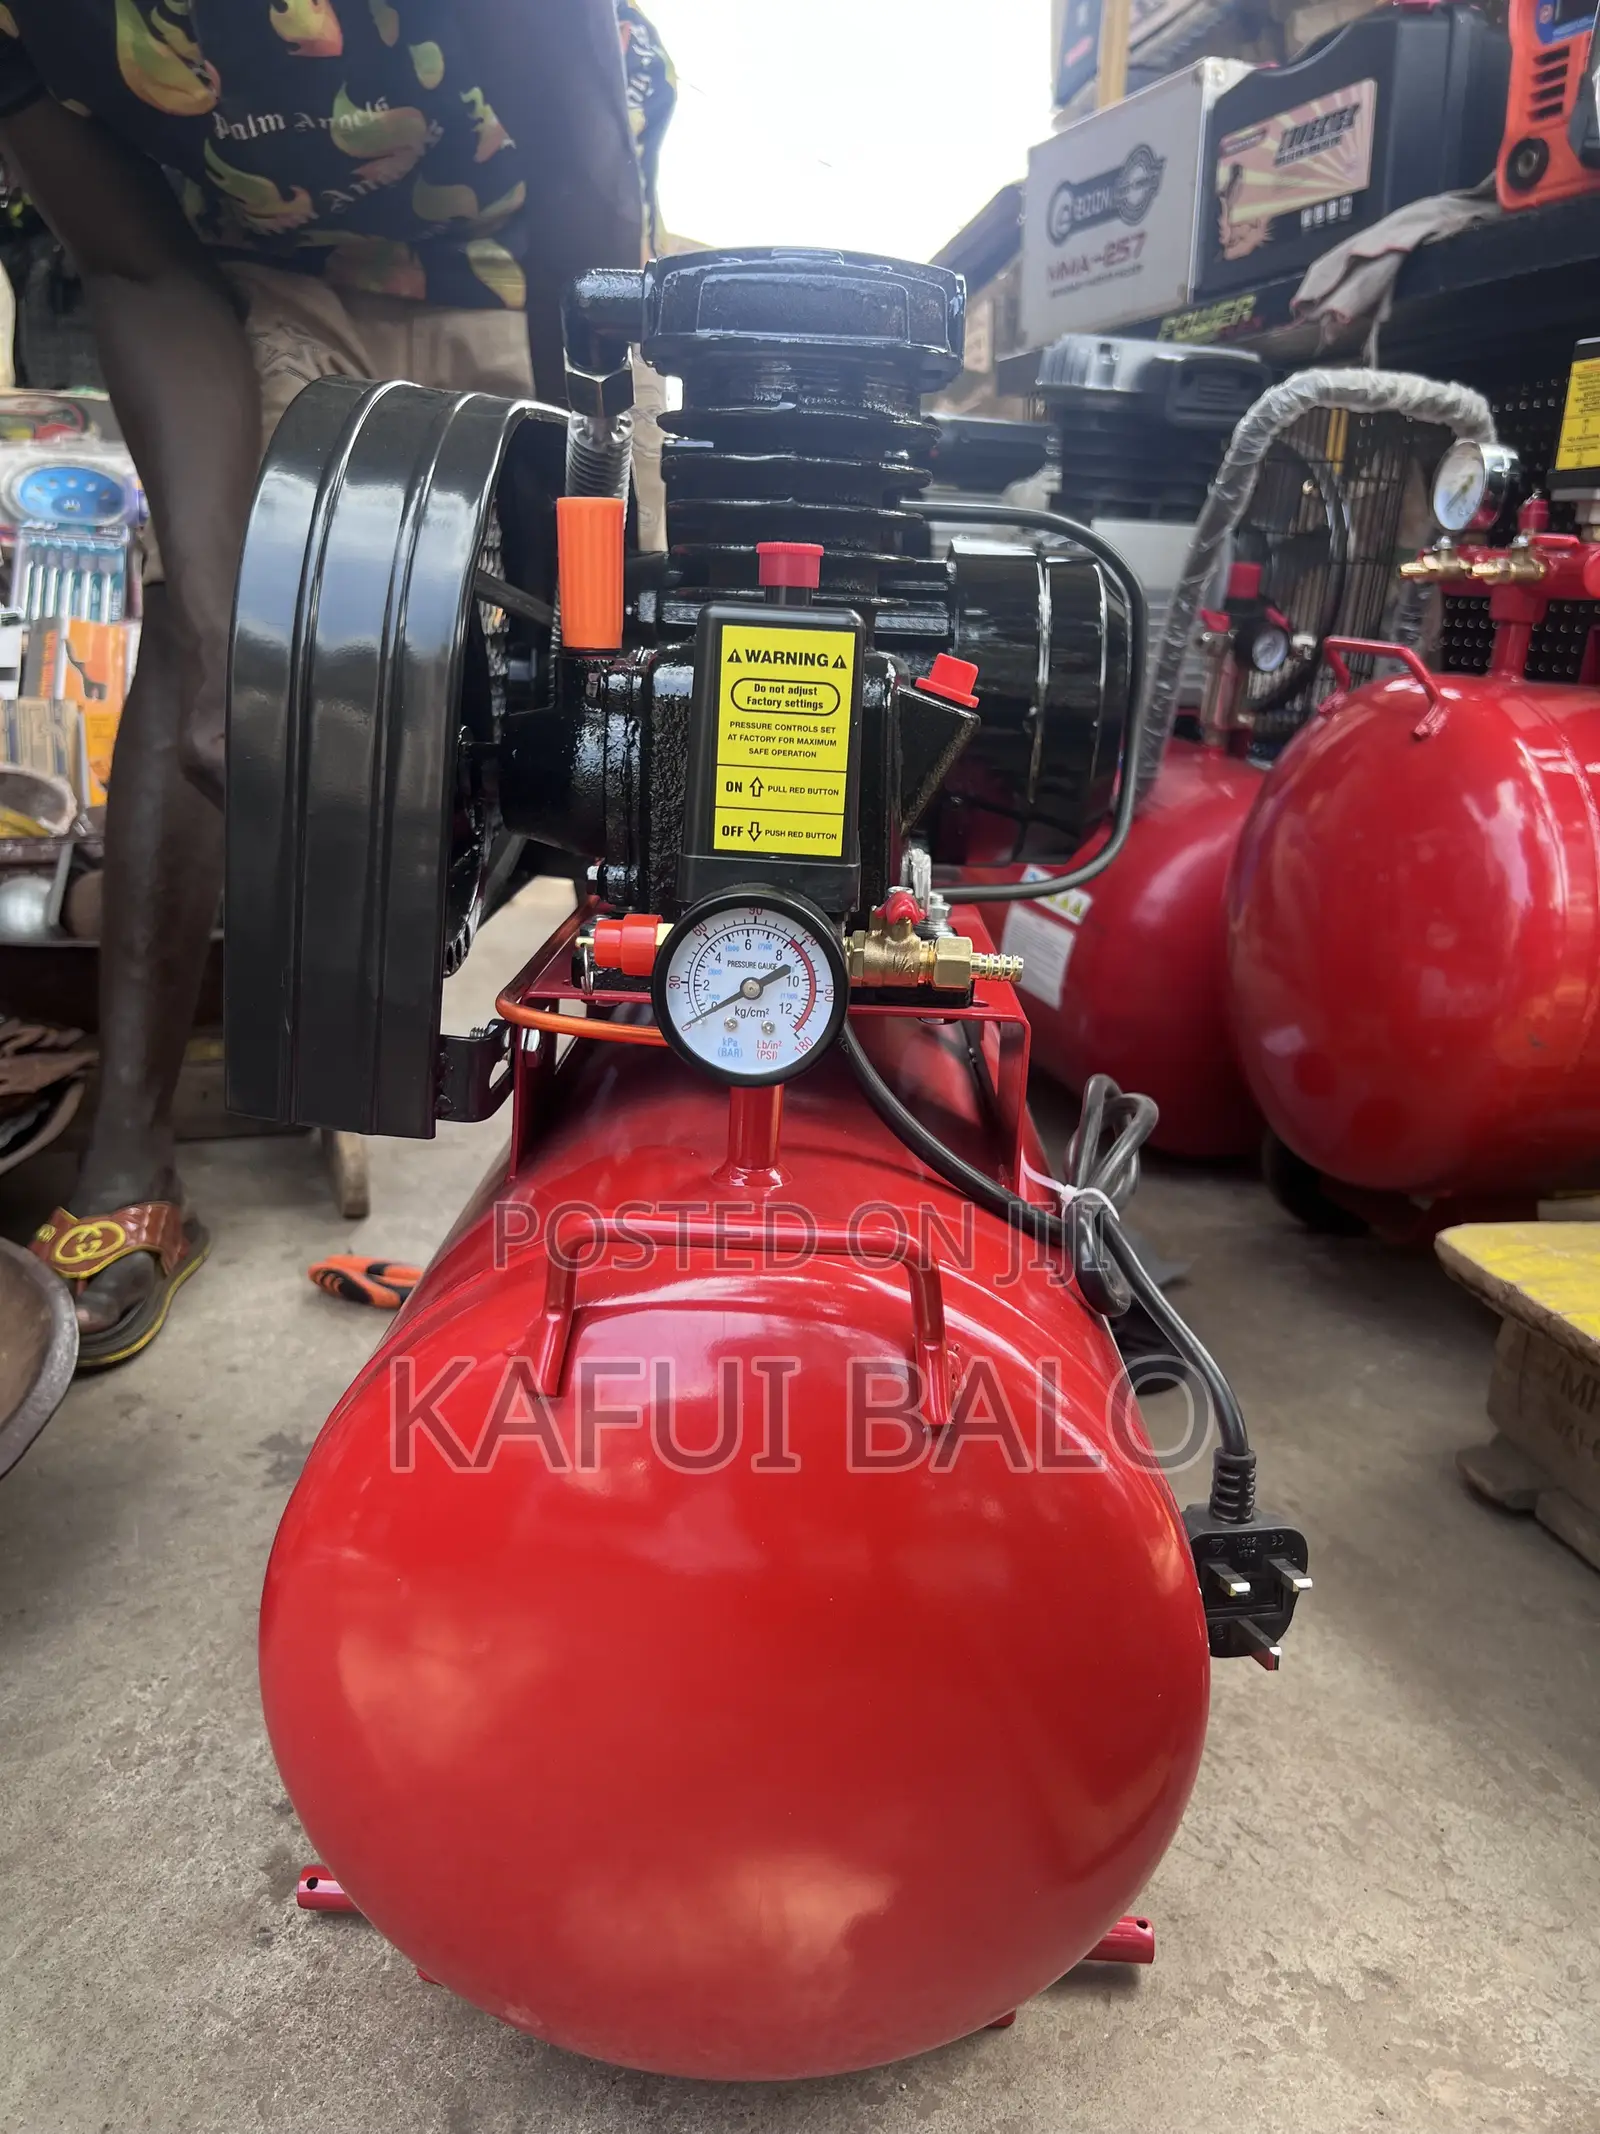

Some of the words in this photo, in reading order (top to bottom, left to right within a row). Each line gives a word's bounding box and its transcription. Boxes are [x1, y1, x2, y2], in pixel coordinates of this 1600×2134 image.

[212, 110, 286, 140] Palm
[745, 649, 829, 667] WARNING
[754, 683, 767, 693] Do
[769, 684, 785, 694] not
[787, 685, 817, 697] adjust
[746, 696, 781, 709] Factory
[784, 698, 823, 711] settings
[729, 720, 772, 731] PRESSURE
[774, 723, 818, 734] CONTROLS
[821, 726, 836, 734] SET
[727, 733, 737, 741] AT
[739, 734, 776, 744] FACTORY
[778, 736, 795, 745] FOR
[797, 737, 837, 747] MAXIMUM
[748, 748, 769, 756] SAFE
[771, 749, 817, 758] OPERATION
[725, 781, 743, 793] ON
[768, 785, 787, 794] PULL
[789, 786, 806, 795] RED
[808, 787, 839, 796] BUTTON
[722, 825, 744, 837] OFF
[765, 829, 786, 838] PUSH
[788, 831, 804, 839] RED
[805, 832, 837, 840] BUTTON
[749, 908, 763, 916] 90
[692, 922, 707, 937] 60
[745, 939, 752, 950] 6
[715, 952, 722, 963] 4
[775, 949, 783, 961] 8
[727, 960, 756, 969] PRESSURE
[758, 961, 778, 970] GAUGE
[669, 975, 681, 989] 30
[703, 980, 710, 991] 2
[787, 975, 800, 987] 10
[824, 984, 835, 1003] 150
[779, 1003, 792, 1015] 12
[723, 1037, 738, 1048] kPa
[794, 1036, 814, 1055] 180
[718, 1047, 743, 1058] (BAR)
[757, 1049, 778, 1060] (PSI)
